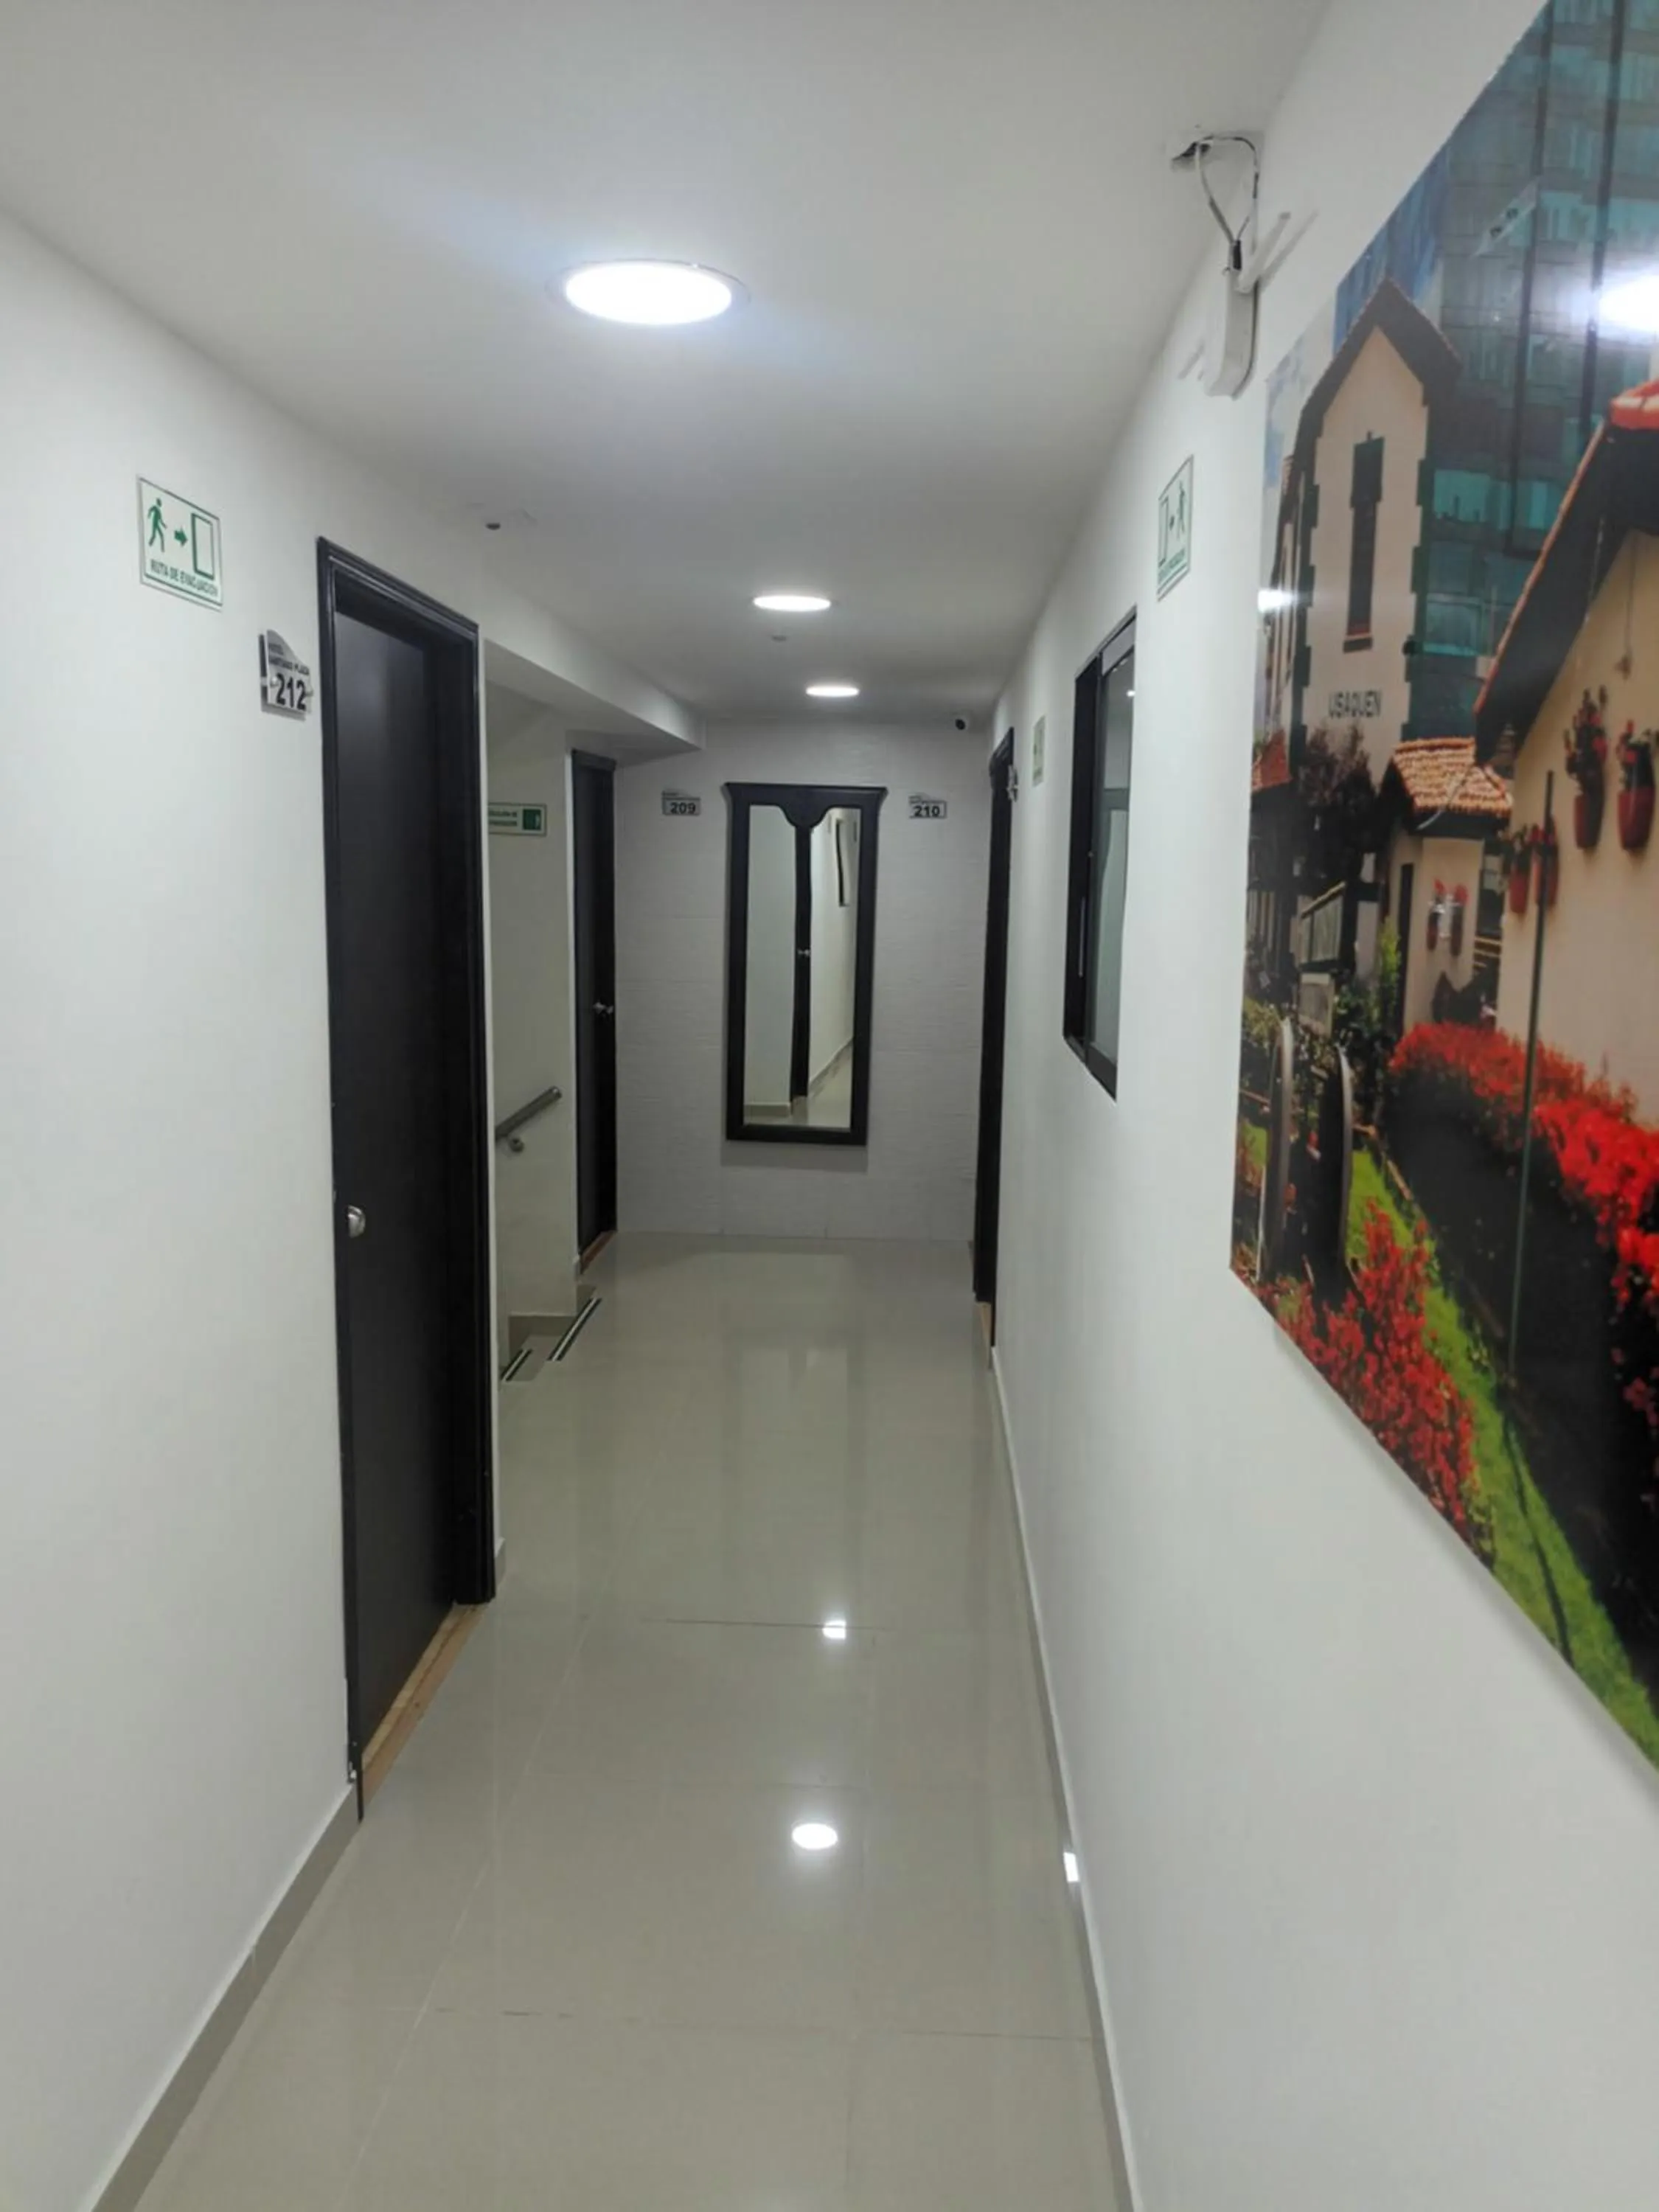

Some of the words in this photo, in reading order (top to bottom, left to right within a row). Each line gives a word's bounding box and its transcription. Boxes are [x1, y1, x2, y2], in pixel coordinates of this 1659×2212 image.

[276, 672, 306, 712] 212
[669, 801, 697, 815] 209
[913, 805, 941, 818] 210
